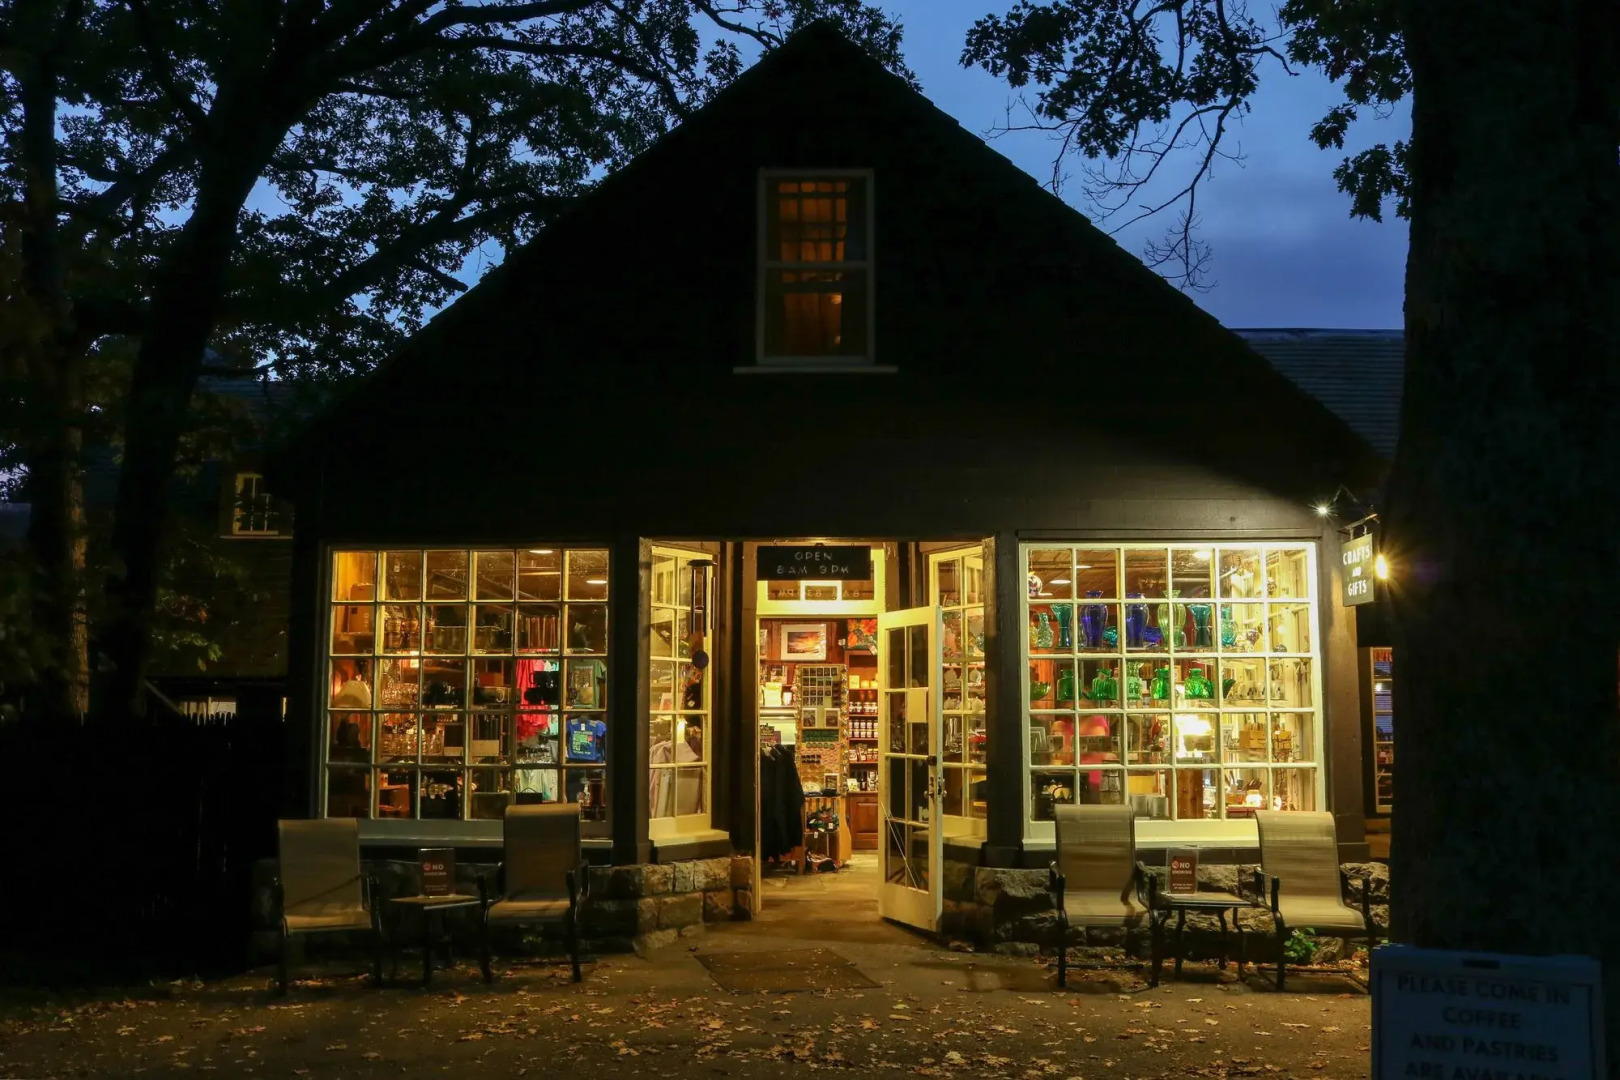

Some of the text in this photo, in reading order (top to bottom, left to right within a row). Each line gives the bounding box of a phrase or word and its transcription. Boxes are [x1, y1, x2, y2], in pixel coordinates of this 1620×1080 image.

[794, 551, 833, 561] OPEN
[1342, 545, 1370, 566] CRAFTS
[1348, 580, 1367, 596] GIFTS
[1398, 974, 1570, 1005] PLEASE COME IN
[1443, 1006, 1521, 1029] COFFEE
[1410, 1033, 1558, 1062] AND PASTRIES
[1406, 1061, 1443, 1079] ARE
